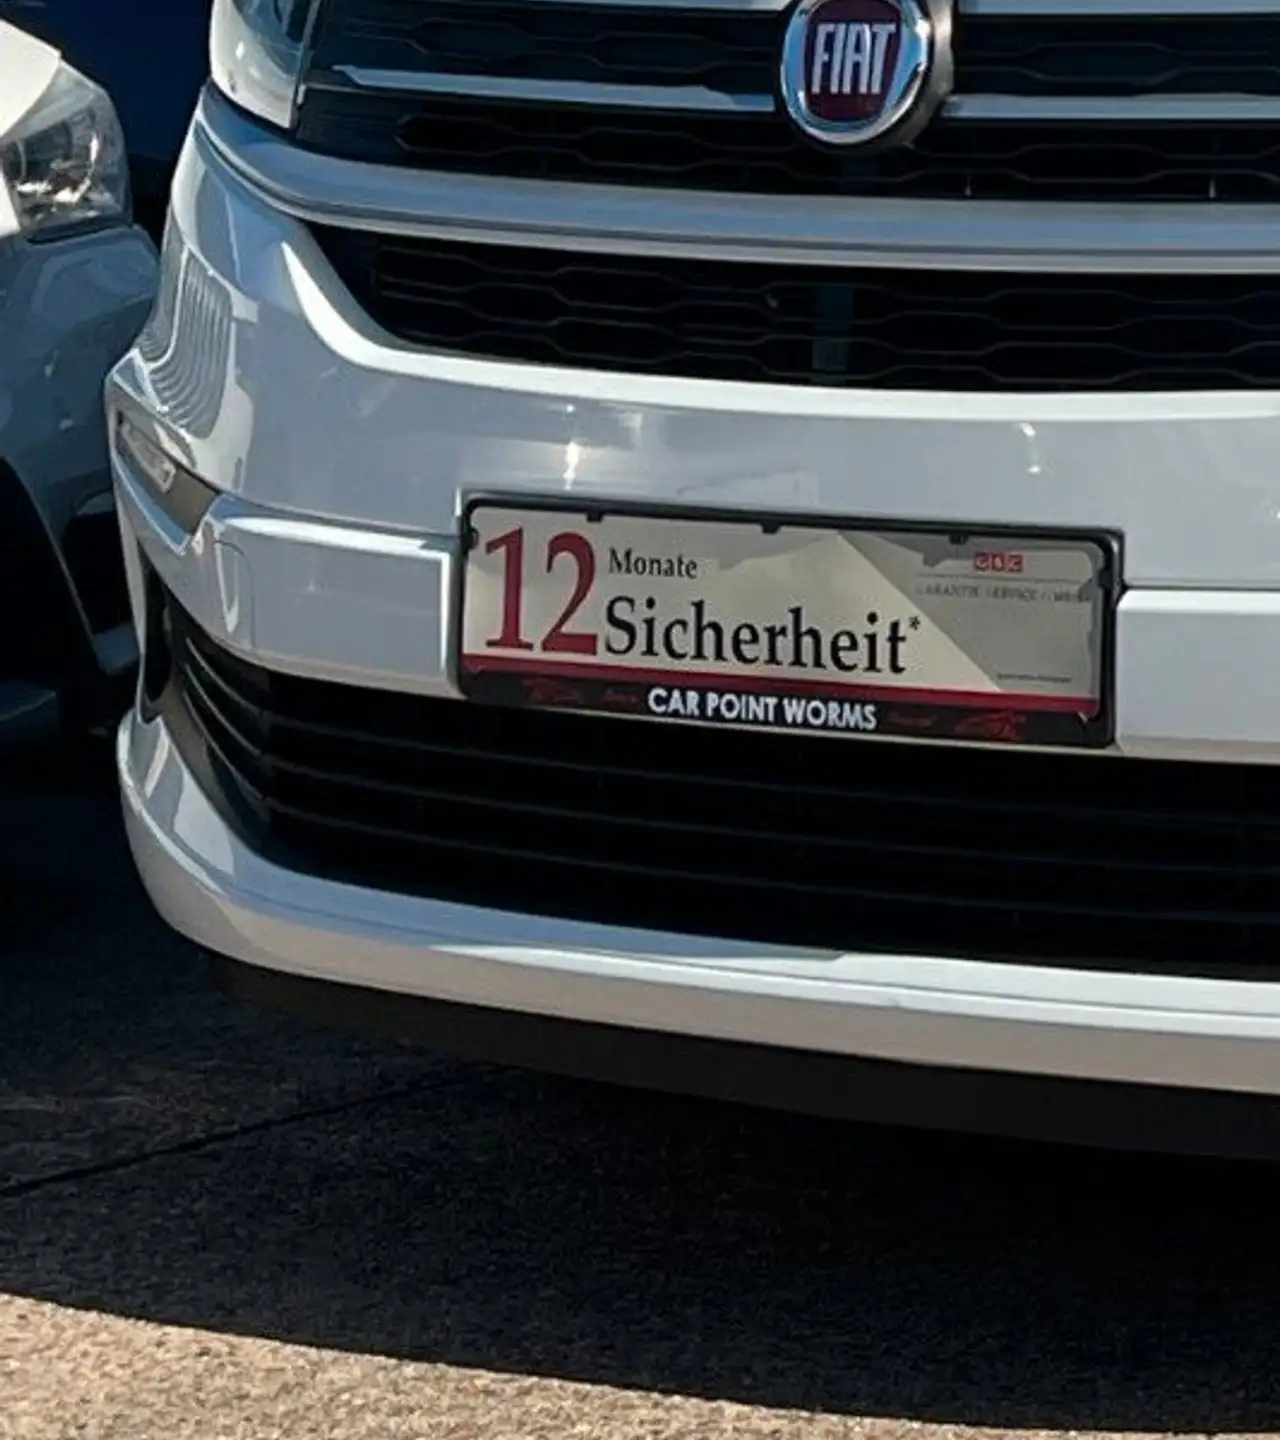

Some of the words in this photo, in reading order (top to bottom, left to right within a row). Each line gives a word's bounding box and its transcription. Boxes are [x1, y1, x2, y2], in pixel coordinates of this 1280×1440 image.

[811, 22, 897, 95] FIAT
[484, 526, 598, 657] 12
[608, 546, 697, 581] Monate
[648, 687, 701, 718] CAR
[706, 691, 781, 725] POINT
[783, 695, 878, 732] WORMS
